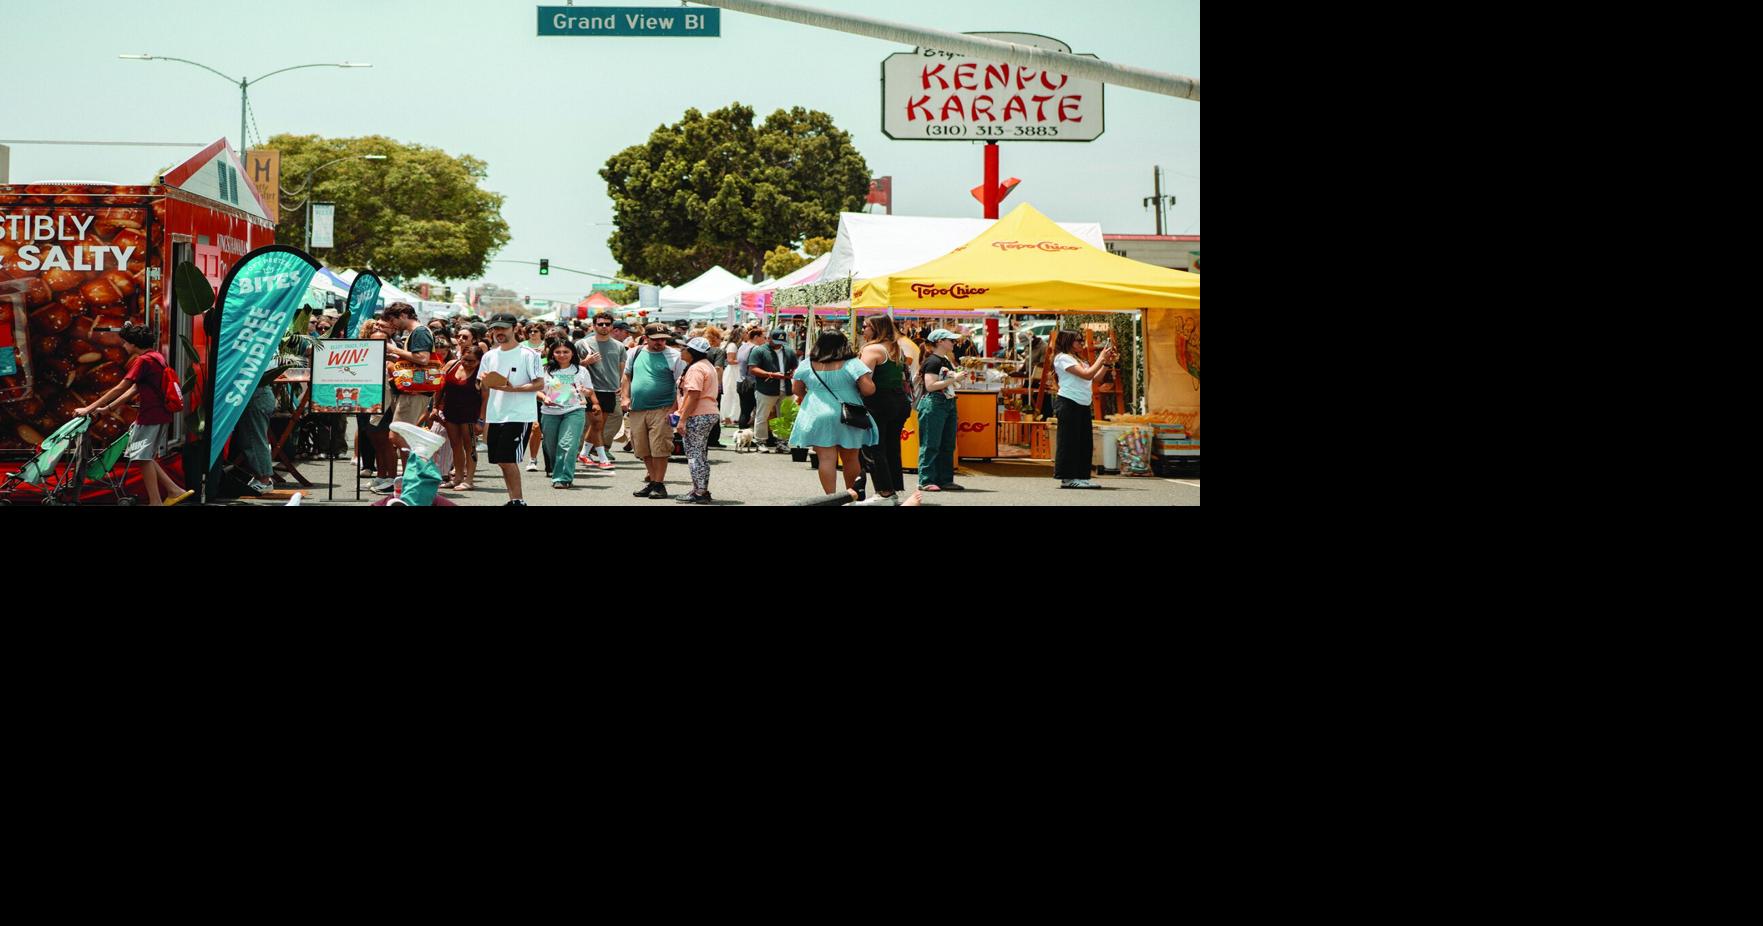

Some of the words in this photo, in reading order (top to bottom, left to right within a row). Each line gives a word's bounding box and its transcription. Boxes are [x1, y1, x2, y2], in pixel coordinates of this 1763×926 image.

[553, 13, 615, 30] Grand
[625, 14, 674, 30] View
[685, 15, 704, 30] Bl
[905, 94, 1083, 122] KARATE
[926, 125, 967, 136] (310)
[976, 126, 1058, 136] 313-3883
[17, 245, 136, 271] SALTY
[239, 270, 301, 295] BITES
[232, 305, 271, 354] FREE
[225, 311, 287, 407] SAMPLES
[327, 348, 369, 366] WIN!
